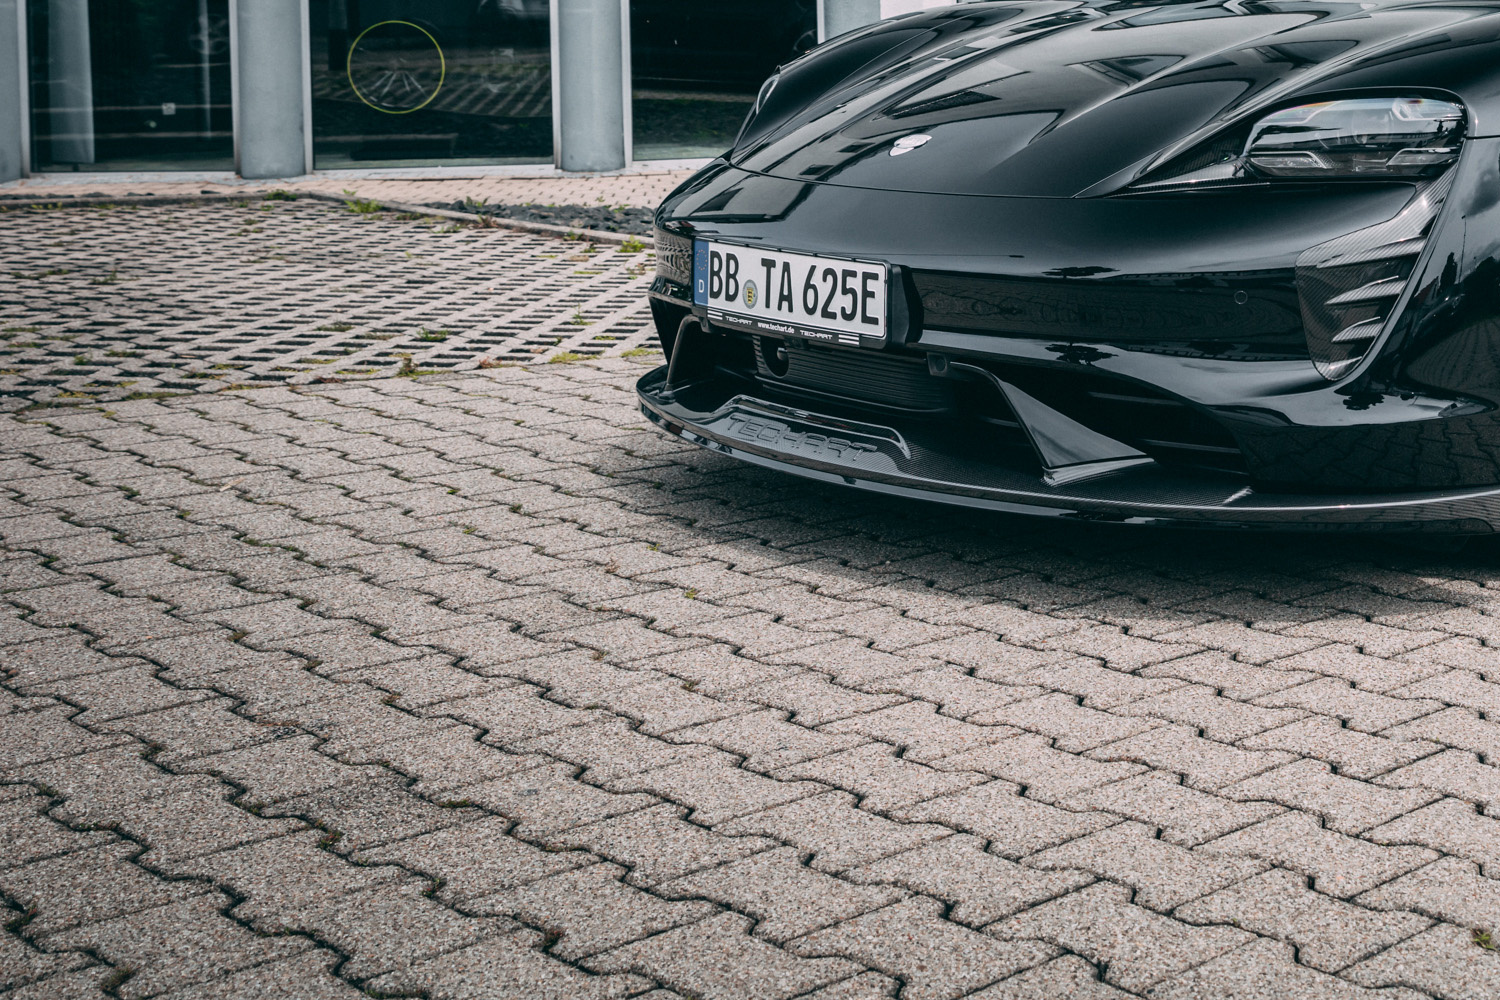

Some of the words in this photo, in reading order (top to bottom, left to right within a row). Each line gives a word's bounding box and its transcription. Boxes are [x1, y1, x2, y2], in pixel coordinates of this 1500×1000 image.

[698, 279, 705, 294] D
[709, 250, 740, 302] BB
[760, 257, 794, 313] TA
[802, 264, 880, 326] 625E
[725, 315, 753, 326] TECHART
[757, 321, 795, 334] www.techart.de
[800, 329, 833, 340] TECHART
[727, 412, 878, 462] TECHART
